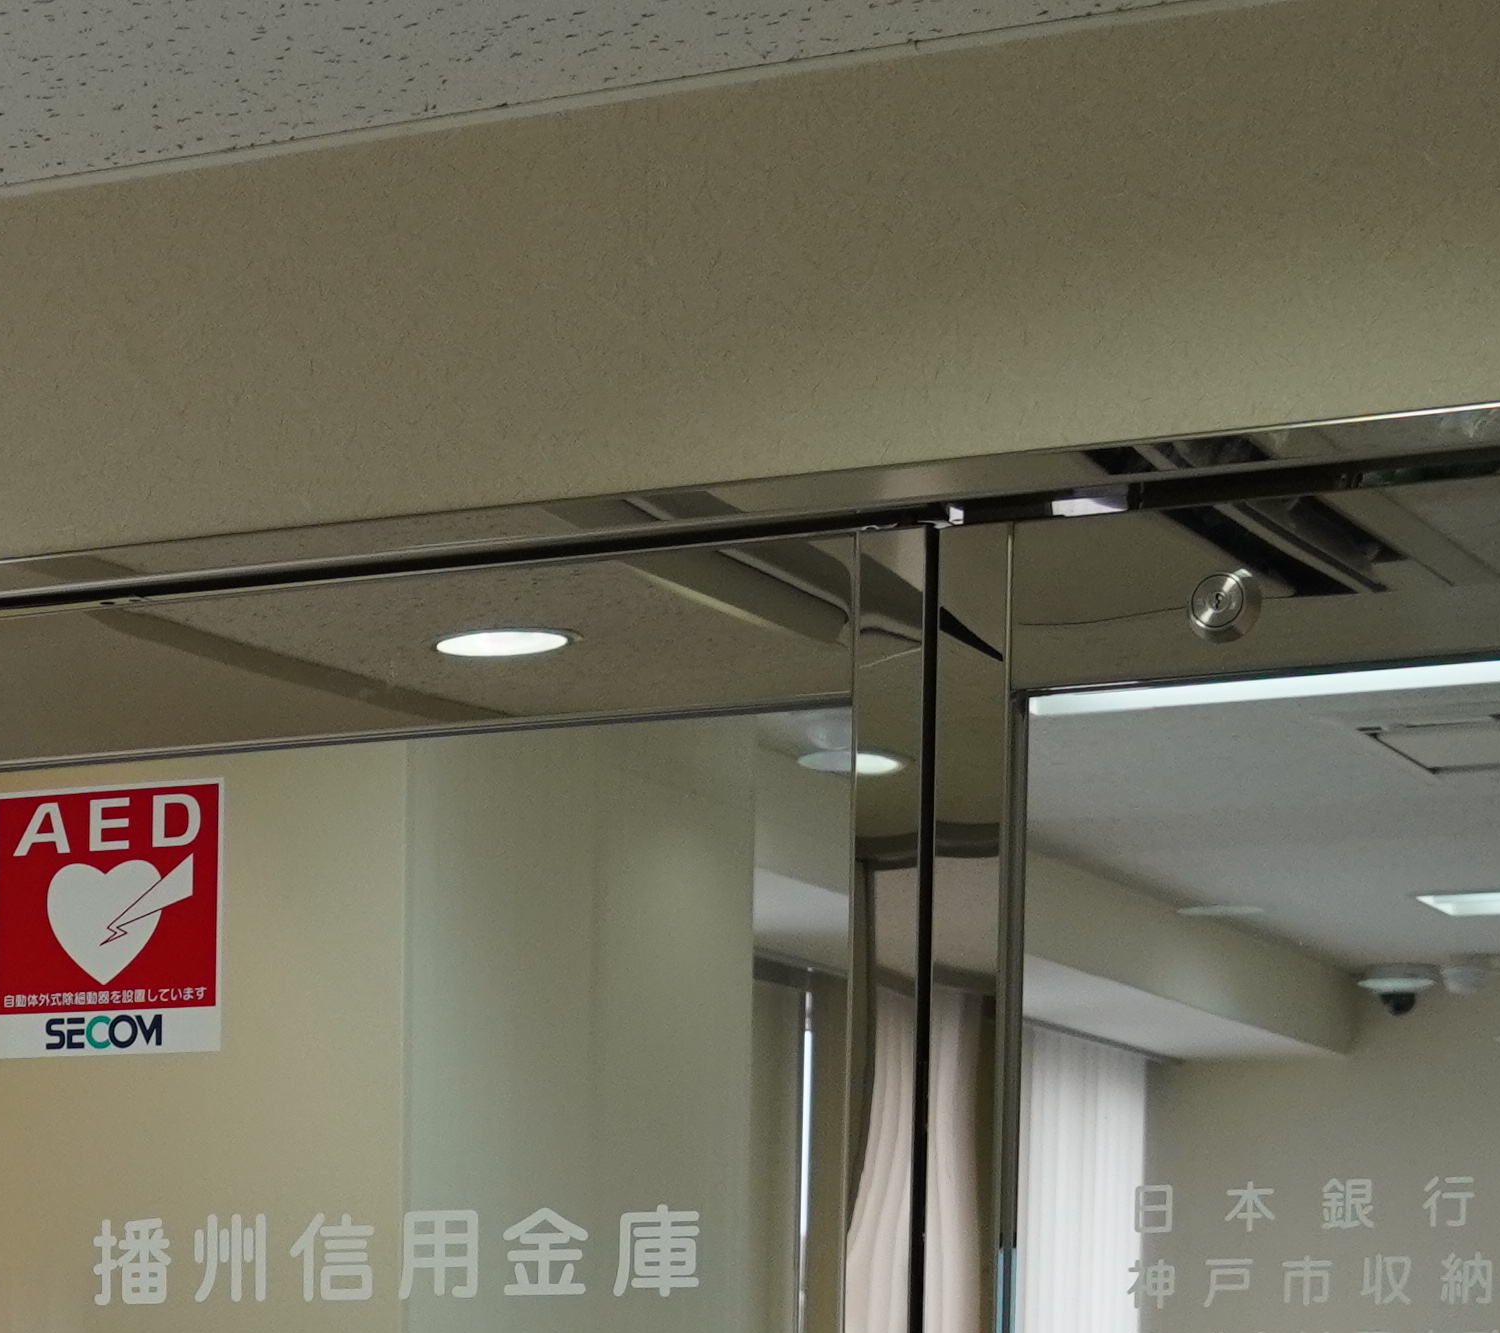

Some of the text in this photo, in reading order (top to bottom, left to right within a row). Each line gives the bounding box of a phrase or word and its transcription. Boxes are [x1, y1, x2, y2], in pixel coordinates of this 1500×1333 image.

[12, 793, 201, 857] AED
[3, 986, 208, 1008] 自動体外式除細動器を設置しています
[45, 1013, 163, 1050] SECOM
[92, 1204, 700, 1306] 播州信用金庫
